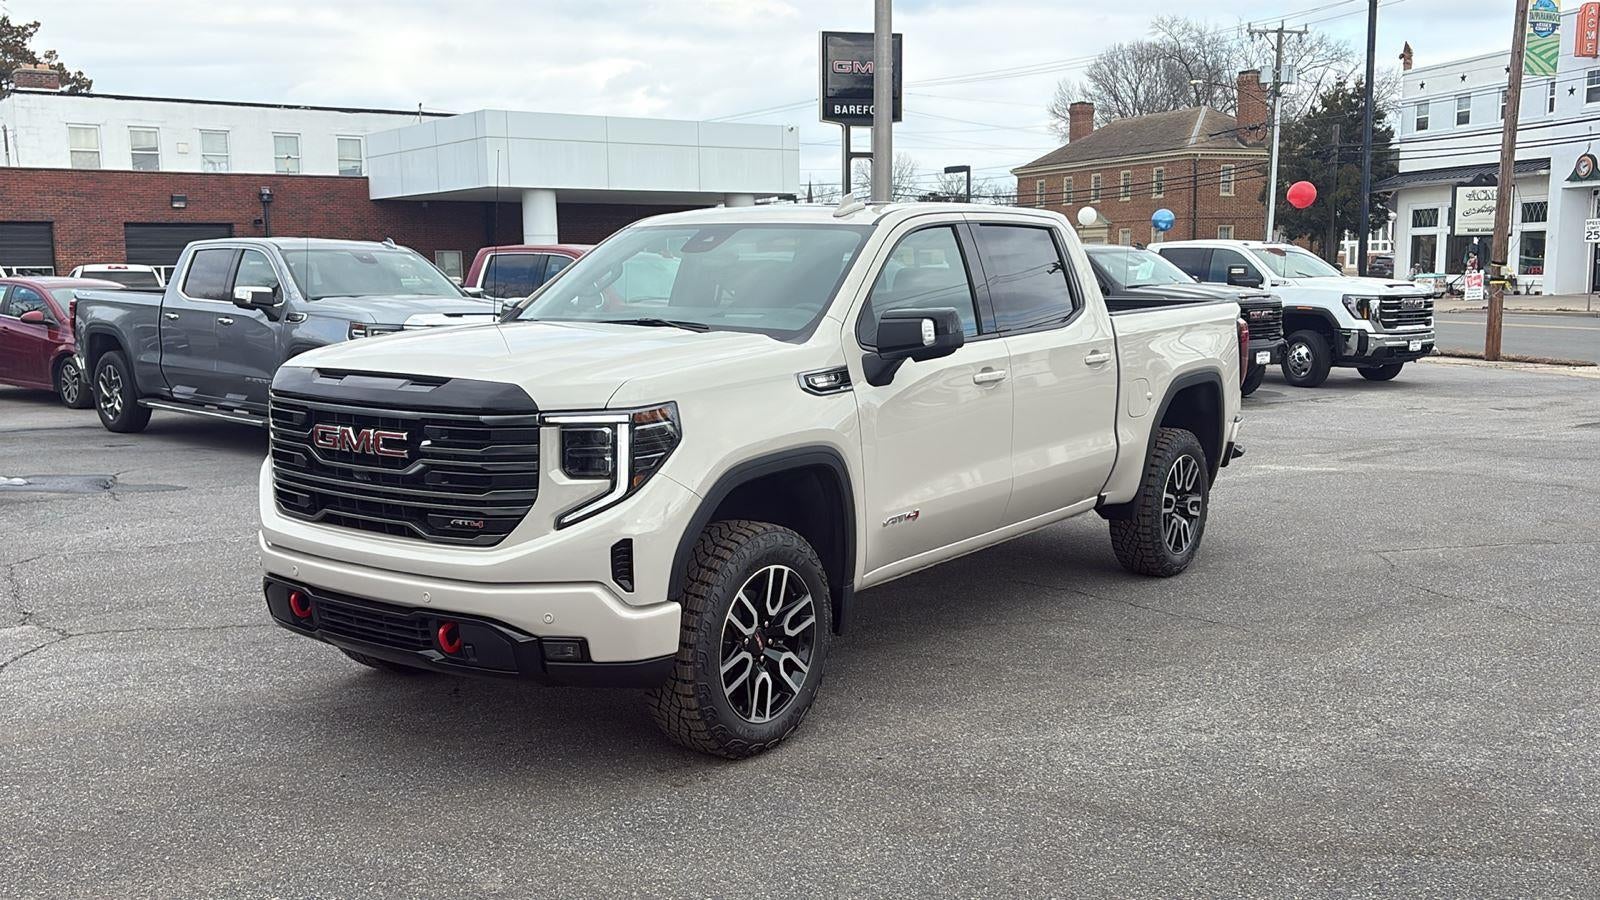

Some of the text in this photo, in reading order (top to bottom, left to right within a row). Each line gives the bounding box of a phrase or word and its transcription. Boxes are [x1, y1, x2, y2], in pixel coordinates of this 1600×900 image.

[1586, 5, 1596, 53] ACME
[832, 60, 874, 74] GM
[834, 104, 875, 115] BAREFO
[1465, 189, 1498, 201] ACM
[1586, 230, 1600, 240] 25
[313, 423, 409, 458] GMC
[450, 519, 484, 529] AT4
[882, 508, 920, 528] AT4
